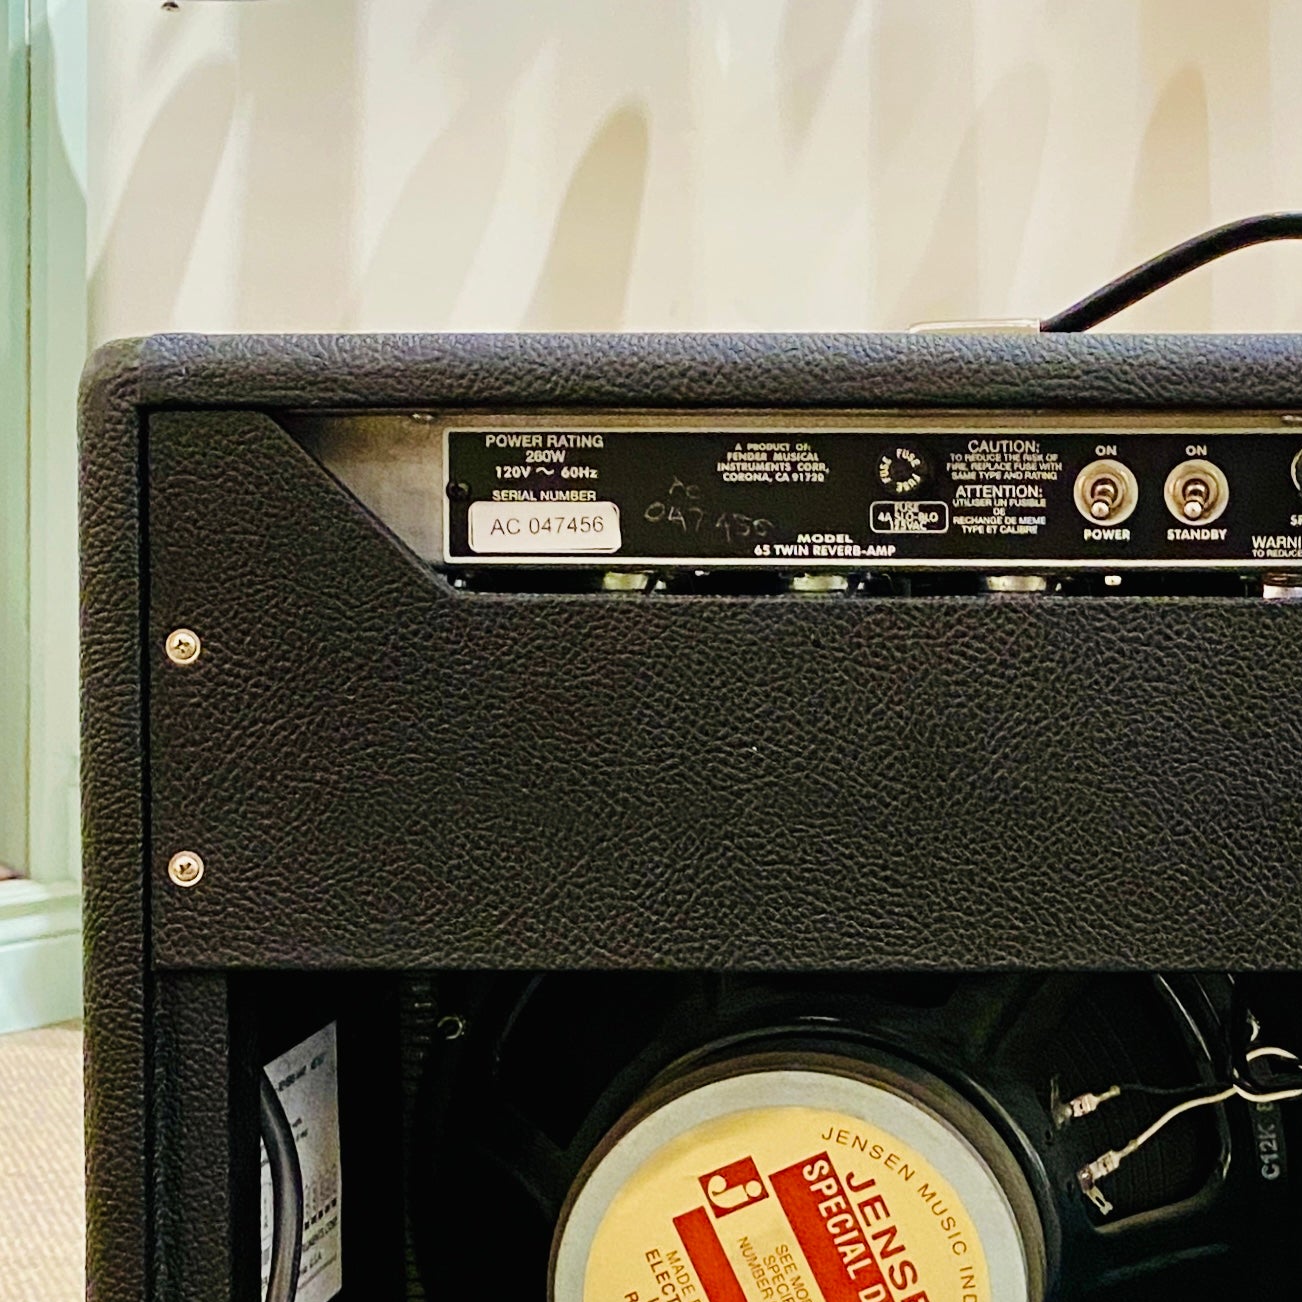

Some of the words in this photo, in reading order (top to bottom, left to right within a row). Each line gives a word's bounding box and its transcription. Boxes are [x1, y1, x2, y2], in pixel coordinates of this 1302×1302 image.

[485, 434, 542, 448] POWER
[547, 434, 604, 448] RATING
[968, 440, 1040, 453] CAUTION:
[735, 443, 742, 451] A
[747, 443, 791, 451] PRODUCT
[1095, 445, 1117, 456] ON
[1185, 445, 1207, 456] ON
[727, 452, 768, 461] FENDER
[773, 452, 820, 461] MUSICAL
[896, 448, 920, 468] FUSE
[950, 453, 962, 461] TO
[965, 453, 1001, 461] REDUCE
[1004, 453, 1021, 461] THE
[1023, 453, 1043, 461] RISK
[1046, 453, 1058, 461] OF
[717, 462, 791, 472] INSTRUMENTS
[971, 462, 1012, 471] REPLACE
[1014, 462, 1037, 471] FUSE
[1039, 462, 1062, 471] WITH
[495, 466, 531, 479] 120V
[561, 466, 599, 479] 60Hz
[723, 473, 772, 482] CORONA,
[775, 473, 790, 482] CA
[951, 472, 976, 480] SAME
[979, 472, 1001, 480] TYPE
[1004, 472, 1023, 480] AND
[1025, 472, 1057, 480] RATING
[492, 490, 537, 501] SERIAL
[540, 490, 596, 501] NUMBER
[956, 485, 1043, 498] ATTENTION:
[952, 499, 992, 507] UTILISER
[994, 499, 1007, 507] UN
[490, 518, 521, 535] AC
[529, 516, 605, 534] 047456
[1005, 516, 1017, 525] DE
[962, 525, 984, 534] TYPE
[986, 525, 997, 534] ET
[1084, 529, 1131, 541] POWER
[1167, 529, 1227, 541] STANDBY
[797, 534, 853, 543] MODEL
[754, 545, 770, 556] 65
[773, 545, 809, 556] TWIN
[813, 545, 896, 556] REVERB-AMP
[1252, 549, 1265, 558] TO
[1266, 549, 1302, 558] REDUCE
[821, 1127, 916, 1182] JENSEN
[917, 1183, 967, 1256] MUSIC
[802, 1159, 872, 1280] SPECIAL
[776, 1244, 798, 1275] SEE
[666, 1250, 696, 1296] MADE
[737, 1236, 774, 1299] NUMBER
